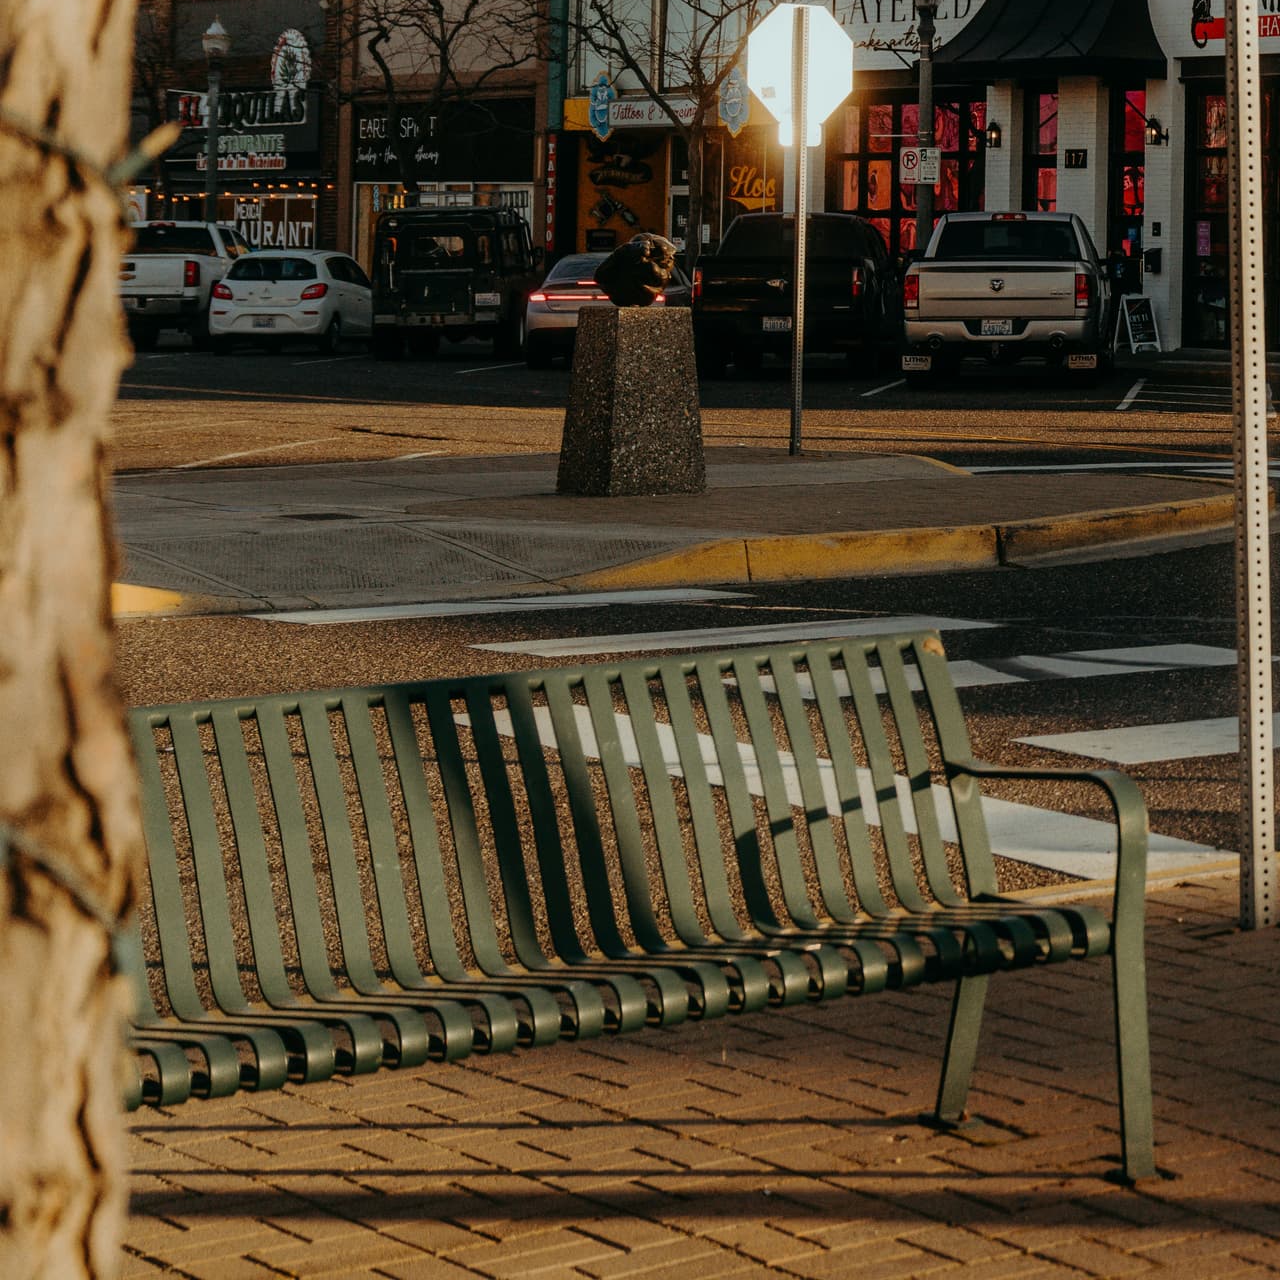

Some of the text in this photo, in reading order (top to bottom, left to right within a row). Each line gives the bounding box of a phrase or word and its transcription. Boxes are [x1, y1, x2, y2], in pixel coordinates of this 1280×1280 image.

[613, 104, 645, 120] Tattoos
[360, 118, 388, 139] EART
[204, 134, 286, 154] STAURANTE
[546, 143, 556, 242] TATTOO
